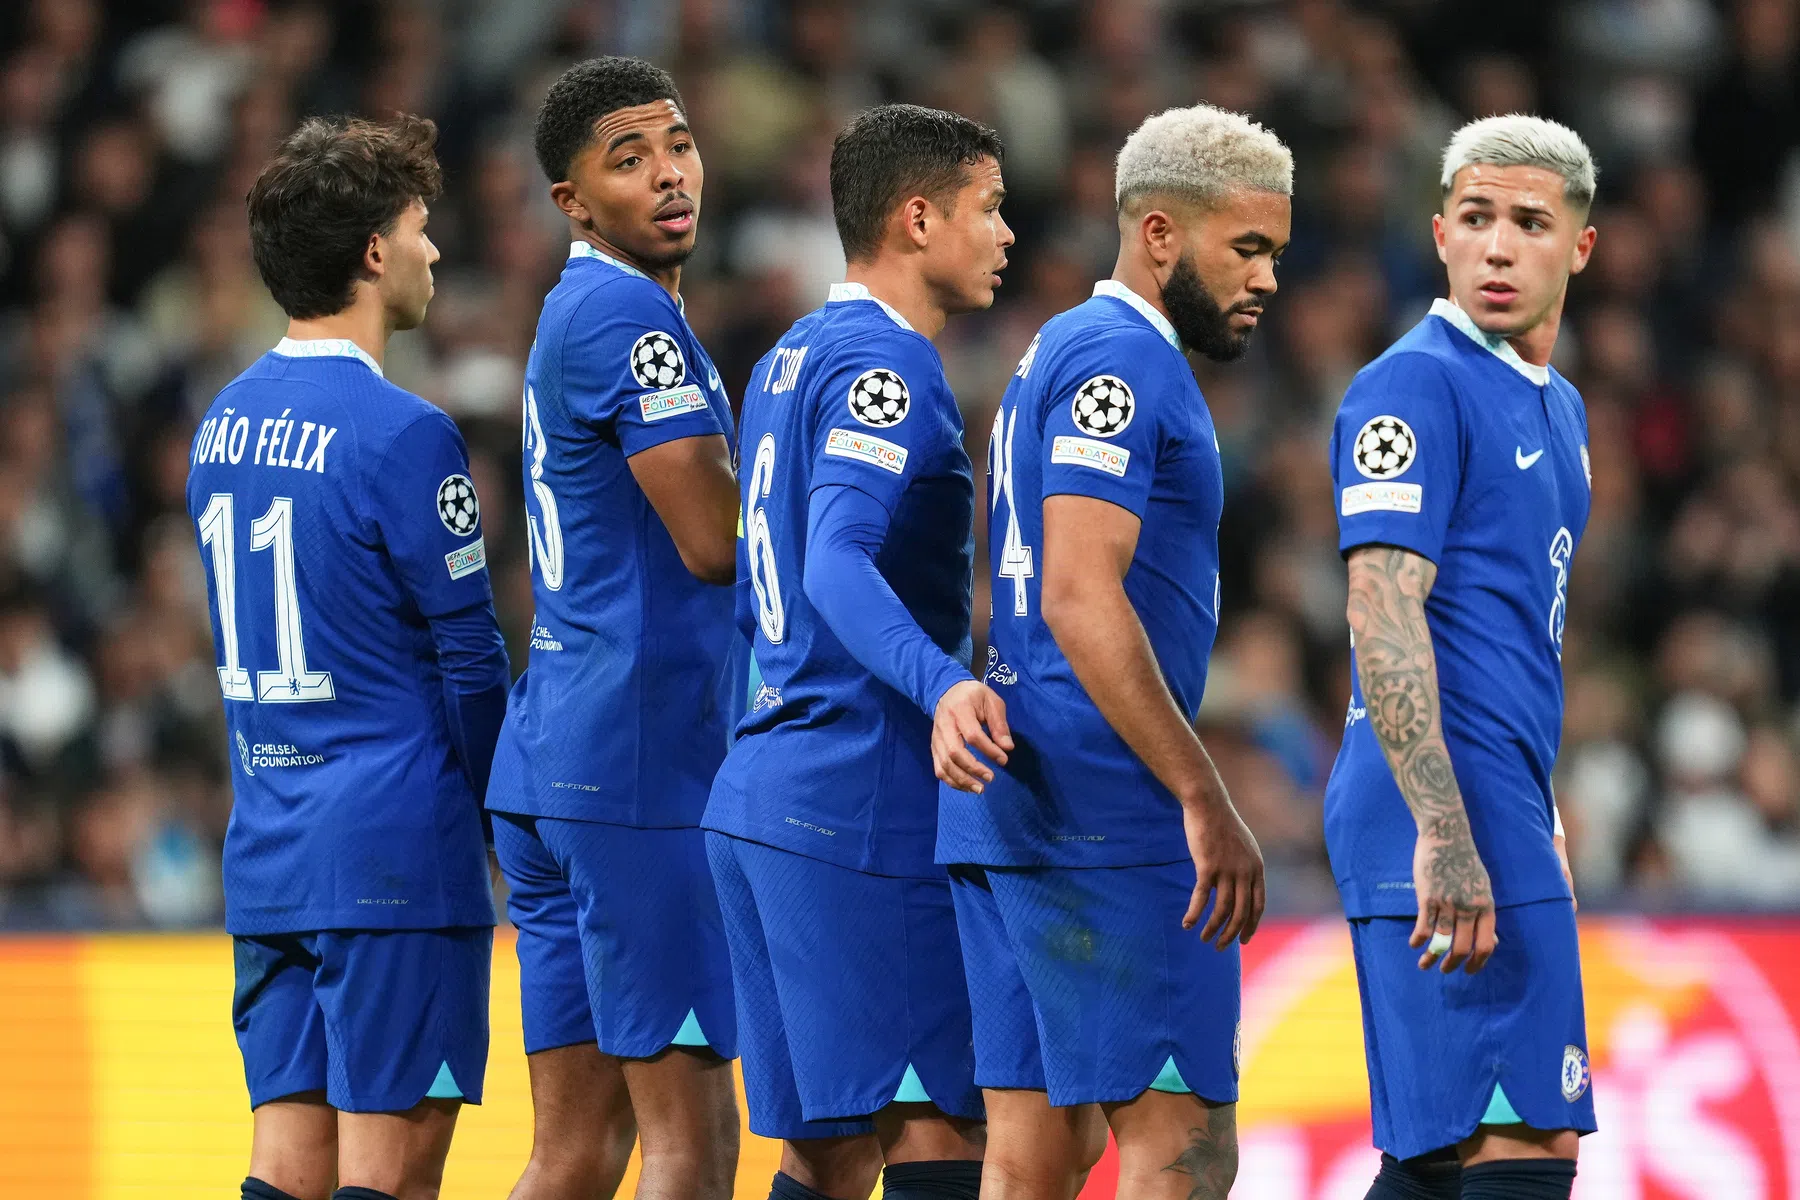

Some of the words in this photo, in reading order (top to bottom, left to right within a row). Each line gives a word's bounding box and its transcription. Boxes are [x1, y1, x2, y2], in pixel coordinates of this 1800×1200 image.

[254, 408, 338, 474] FÉLIX
[831, 430, 849, 438] UEFA
[829, 436, 905, 465] FOUNDATION
[1055, 444, 1127, 468] FOUNDATION
[522, 379, 564, 591] 3
[1344, 491, 1419, 504] FNATION
[747, 432, 785, 645] 6
[198, 493, 336, 703] 11
[252, 743, 299, 755] CHELSEA
[252, 754, 325, 767] FOUNDATION
